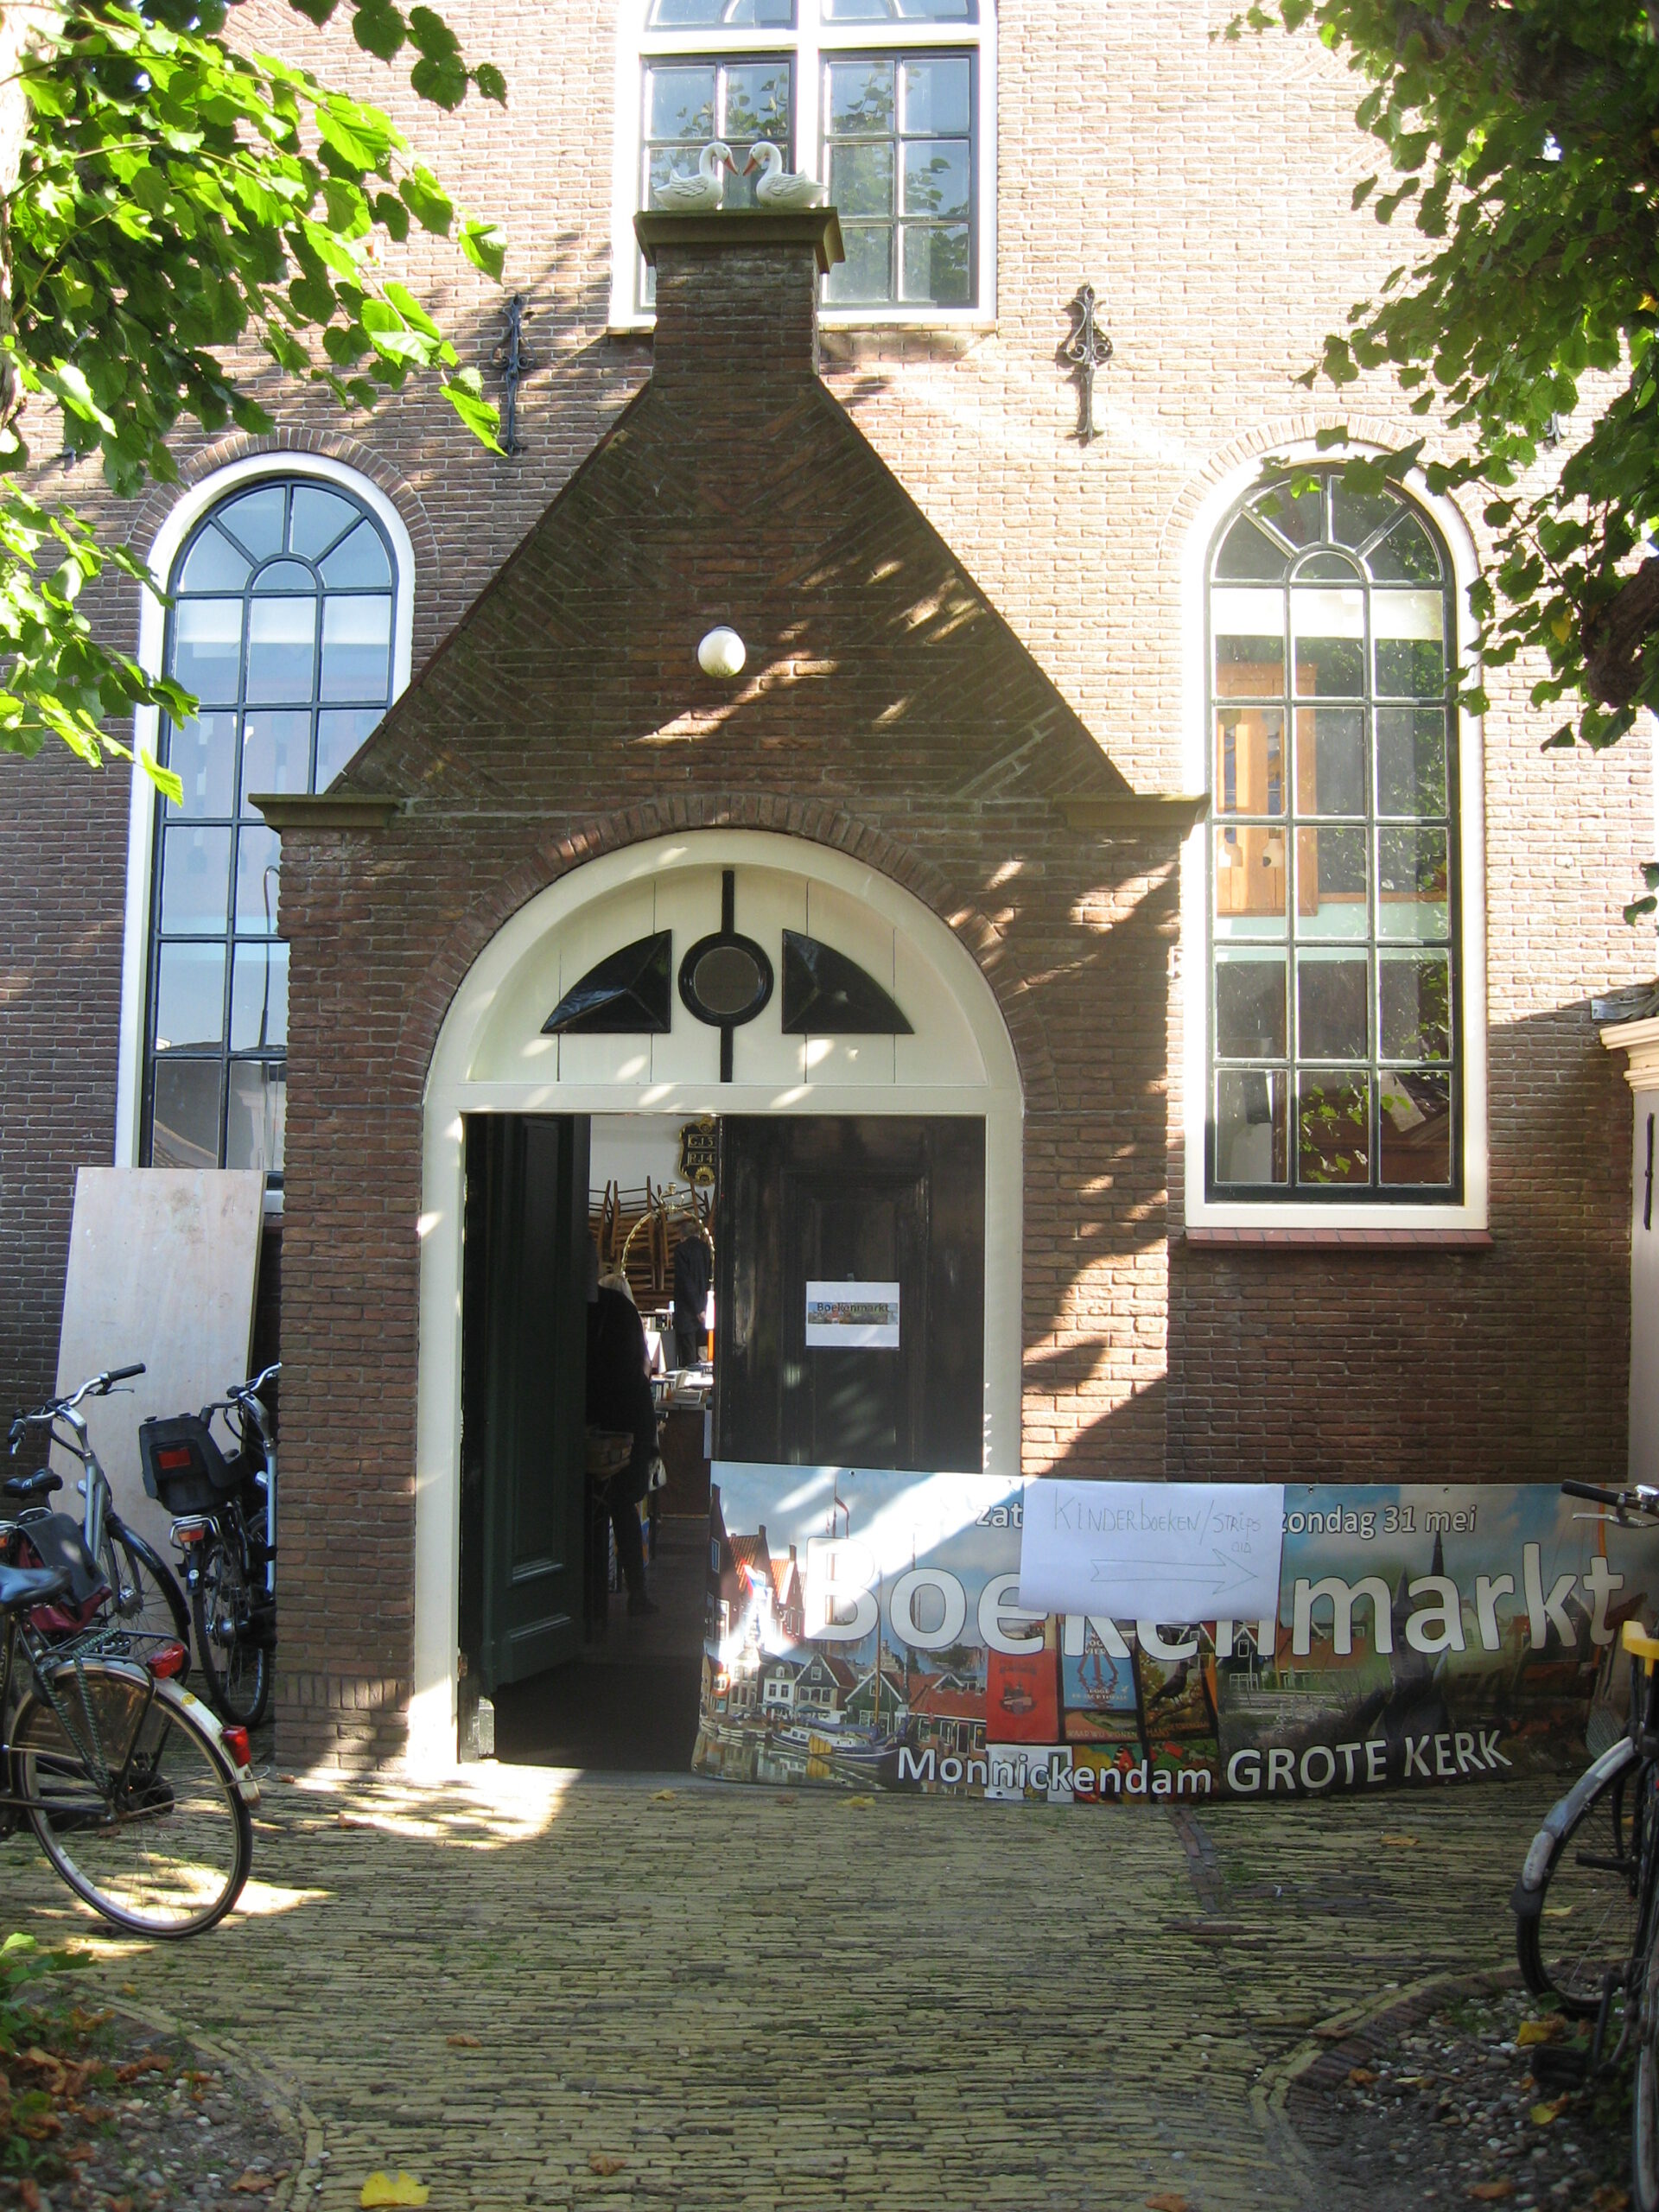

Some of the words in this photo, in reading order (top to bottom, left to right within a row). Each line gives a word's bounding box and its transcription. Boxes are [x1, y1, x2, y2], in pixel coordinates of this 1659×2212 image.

[1382, 1505, 1416, 1533] 31
[1425, 1504, 1478, 1533] mei
[897, 1745, 1212, 1796] Monnickendam
[1226, 1738, 1388, 1793] GROTE
[1403, 1729, 1513, 1778] KERK
